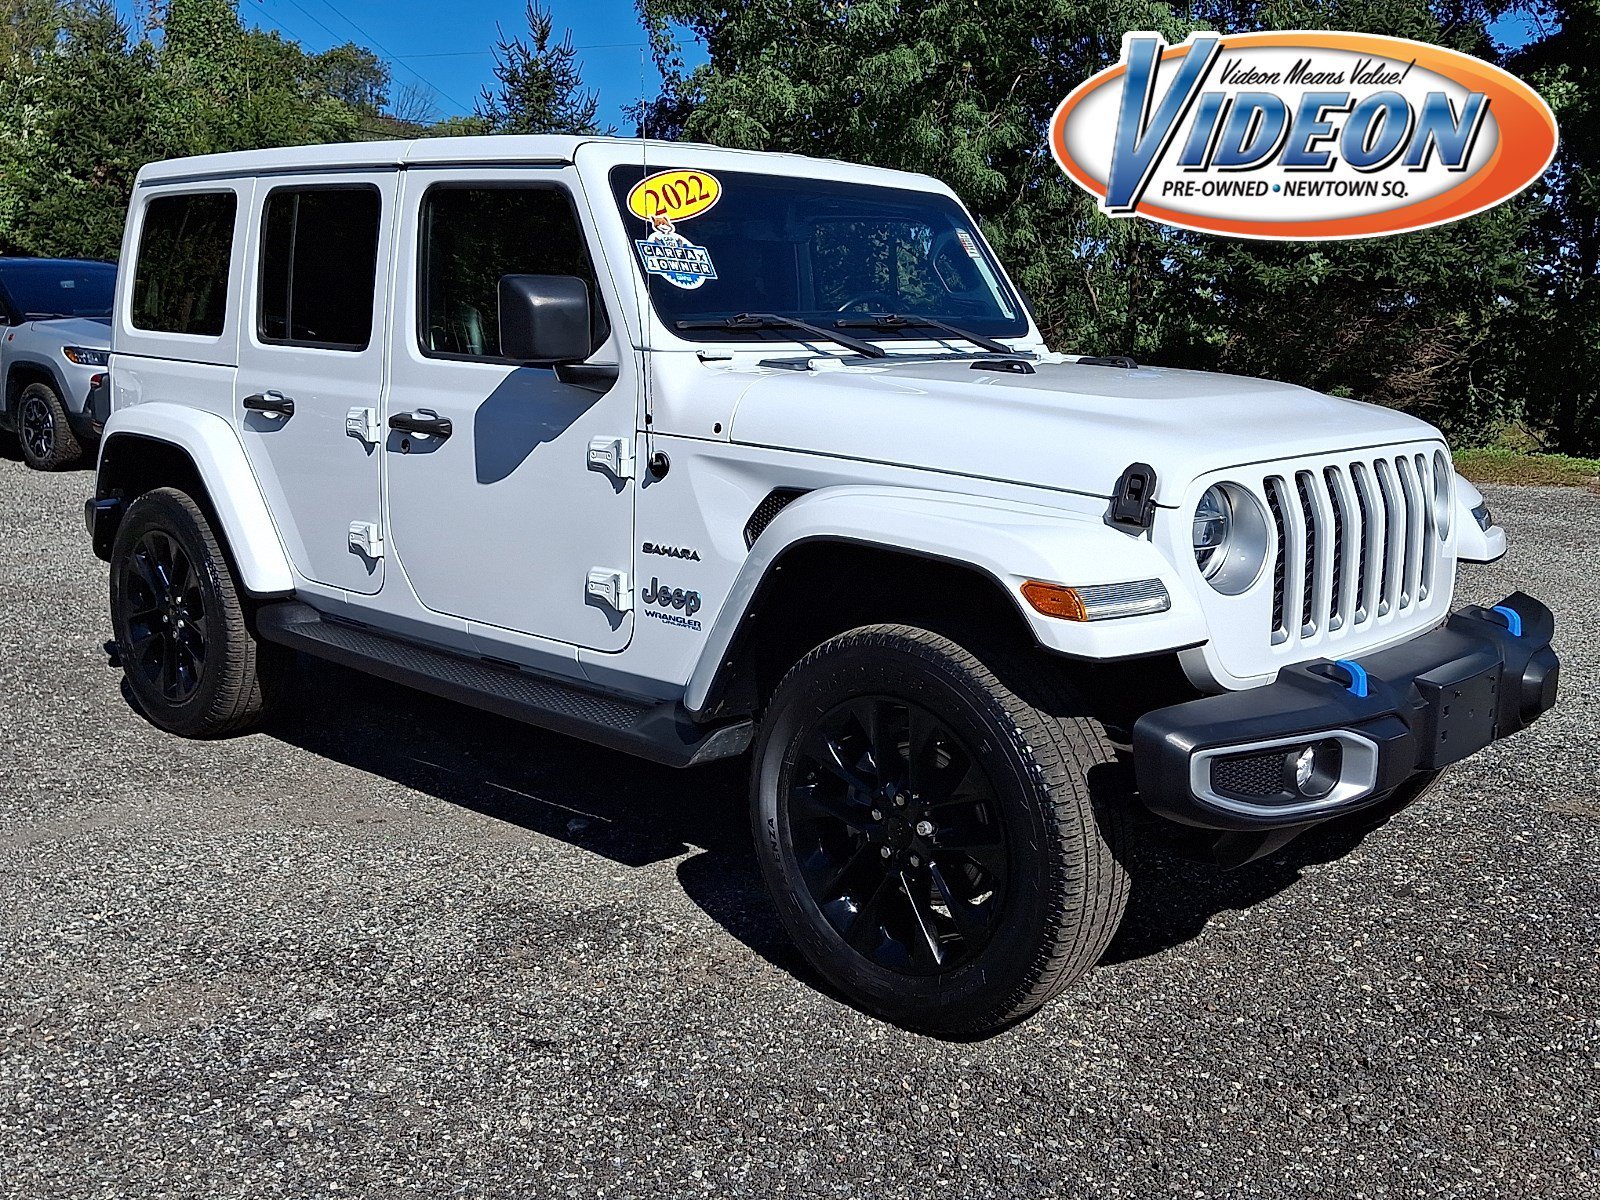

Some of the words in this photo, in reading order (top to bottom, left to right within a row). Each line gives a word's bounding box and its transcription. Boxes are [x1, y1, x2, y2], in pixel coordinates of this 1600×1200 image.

[645, 175, 710, 215] 2022
[643, 244, 706, 261] CARFAX
[642, 542, 702, 562] SAHARA
[642, 577, 702, 617] Jeep
[644, 609, 702, 628] WRANGLER
